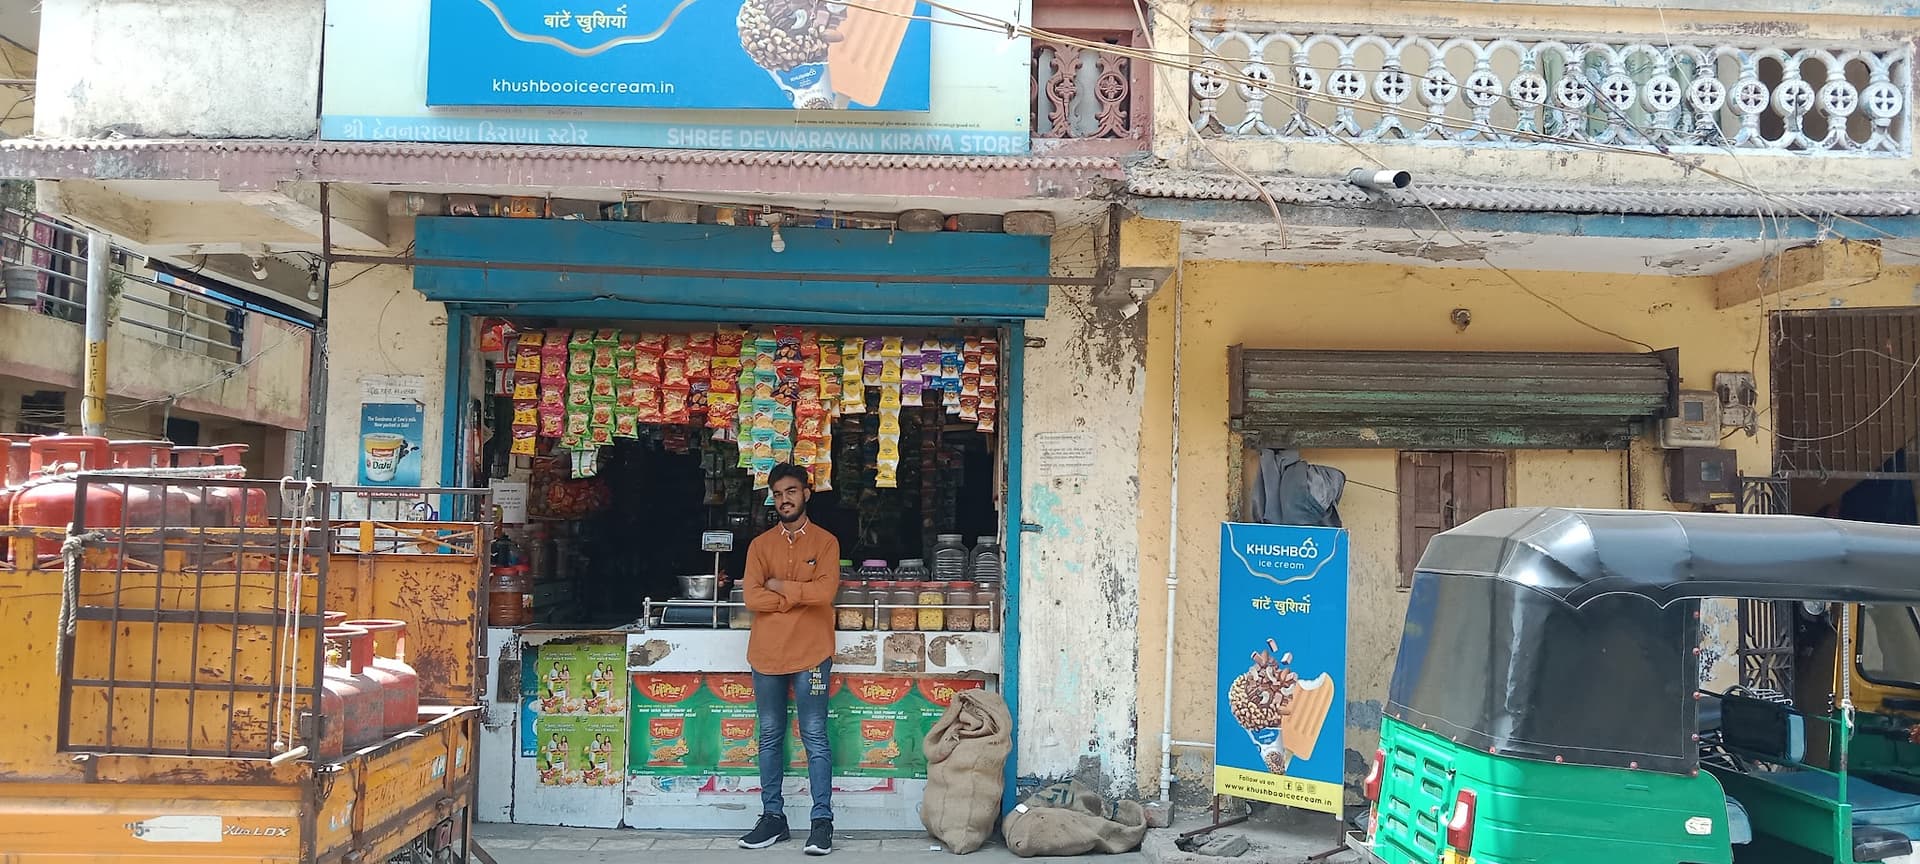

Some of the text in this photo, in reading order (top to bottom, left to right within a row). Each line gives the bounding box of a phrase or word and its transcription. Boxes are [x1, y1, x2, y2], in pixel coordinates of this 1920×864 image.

[492, 79, 675, 95] khushbooicecream.in
[667, 127, 1024, 153] SHREE DEVNARAYAN KIRANA STORE
[372, 460, 393, 470] Dahi
[1246, 537, 1319, 559] KHUSHBOO
[1258, 560, 1305, 570] ice cream
[1238, 774, 1259, 784] Follow
[1225, 782, 1332, 806] www.khushbooicecream.in
